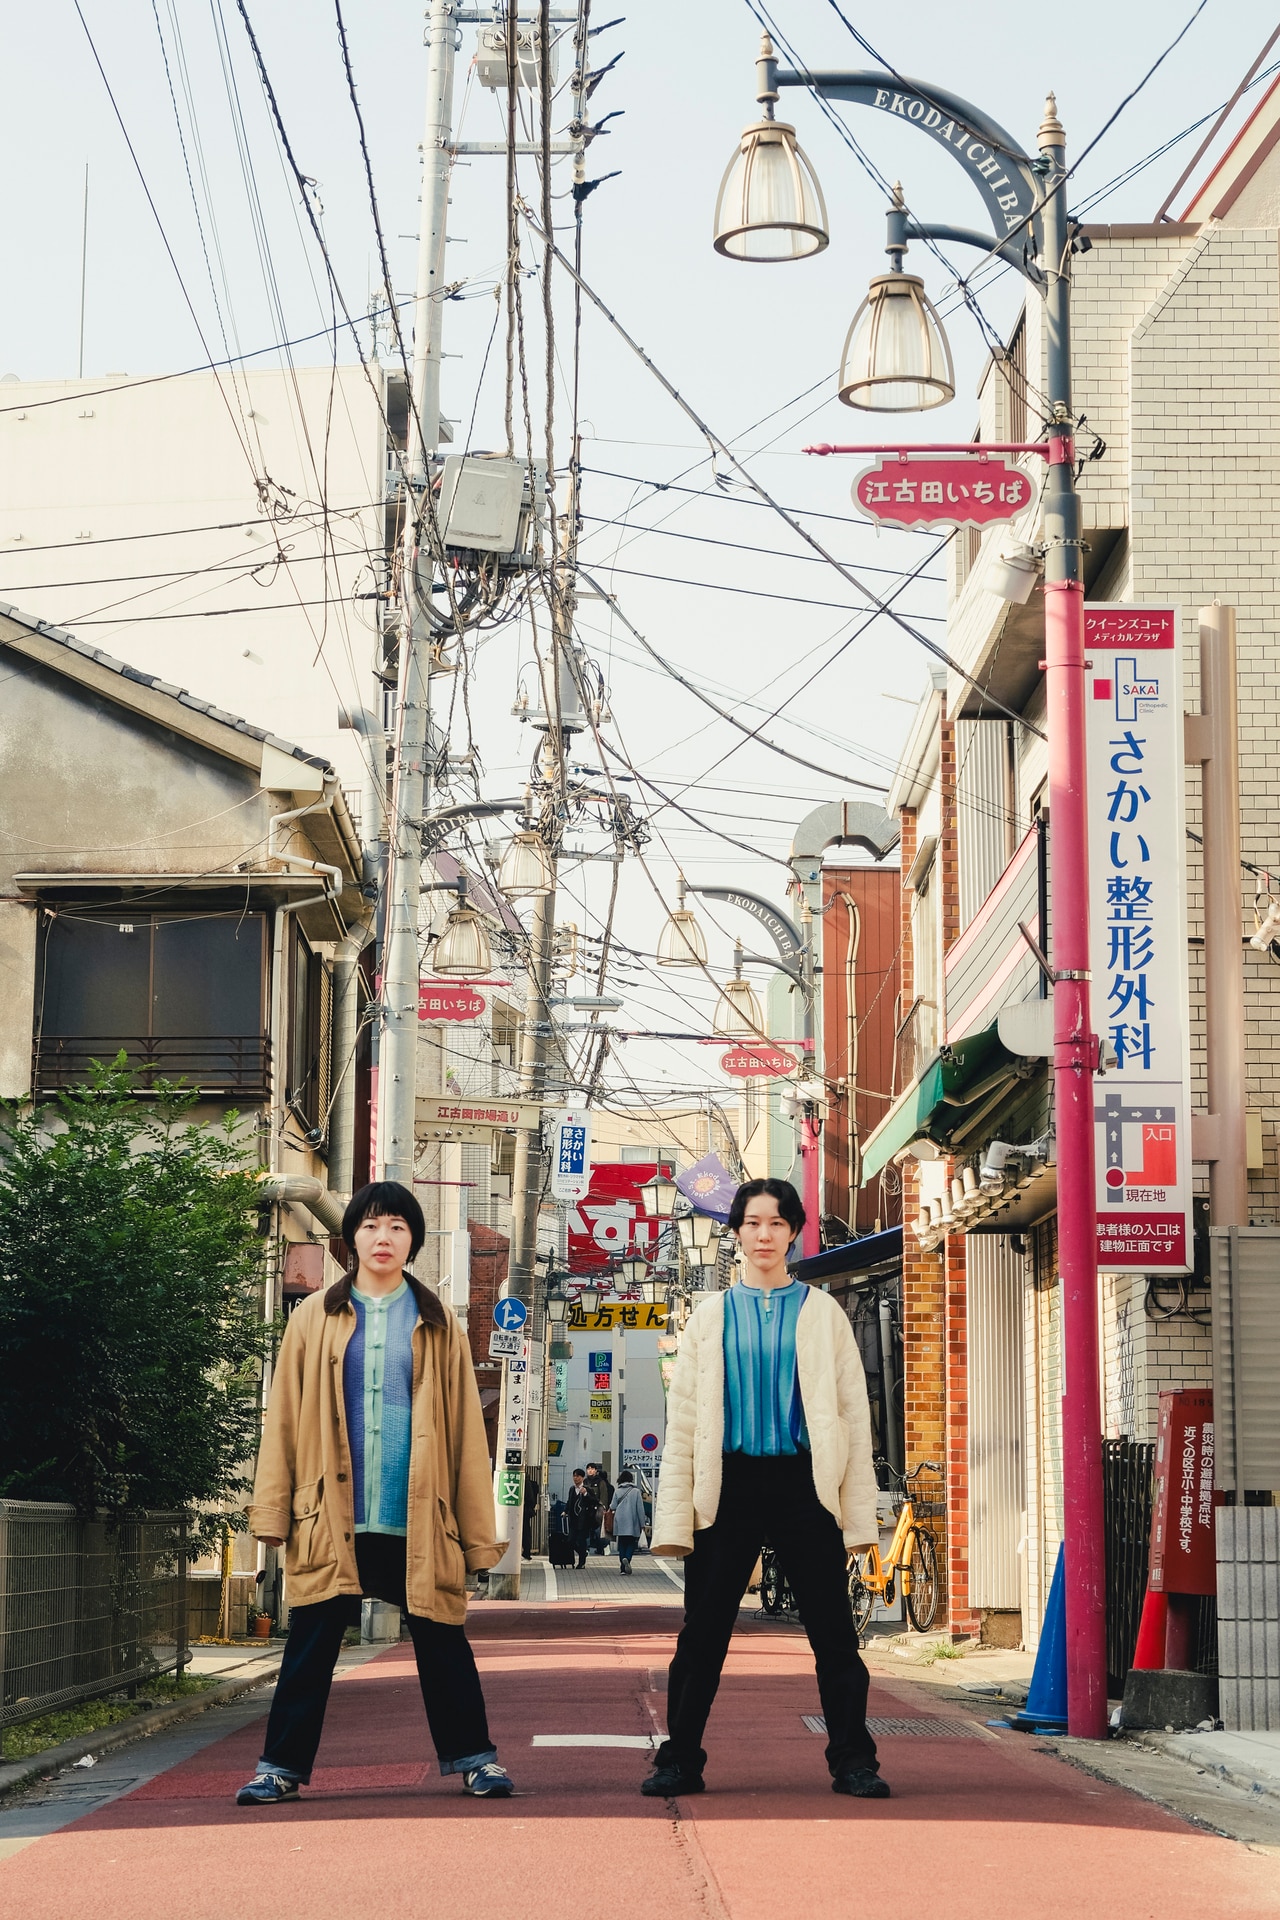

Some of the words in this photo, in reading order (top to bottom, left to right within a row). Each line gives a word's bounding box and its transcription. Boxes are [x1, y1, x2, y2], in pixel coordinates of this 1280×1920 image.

[873, 89, 1024, 230] EKODAICHIBA
[865, 478, 1023, 504] 江古田いちば
[1086, 618, 1169, 630] クイーンズコート
[1092, 632, 1161, 642] メディカルプラザ
[1106, 730, 1156, 1070] さかい整形外科
[437, 1106, 519, 1123] 江古田市場通り
[572, 1128, 583, 1161] さかい
[1145, 1128, 1172, 1141] 入口
[560, 1127, 573, 1172] 整形外科
[1126, 1189, 1166, 1202] 現在地
[1100, 1240, 1175, 1253] 建物正面です
[568, 1304, 666, 1328] 処方せん
[595, 1353, 606, 1367] P
[511, 1374, 522, 1424] まるや
[1199, 1422, 1214, 1528] 震災時の避難拠点は、
[1179, 1426, 1196, 1553] 近くの区立小・中学校です。
